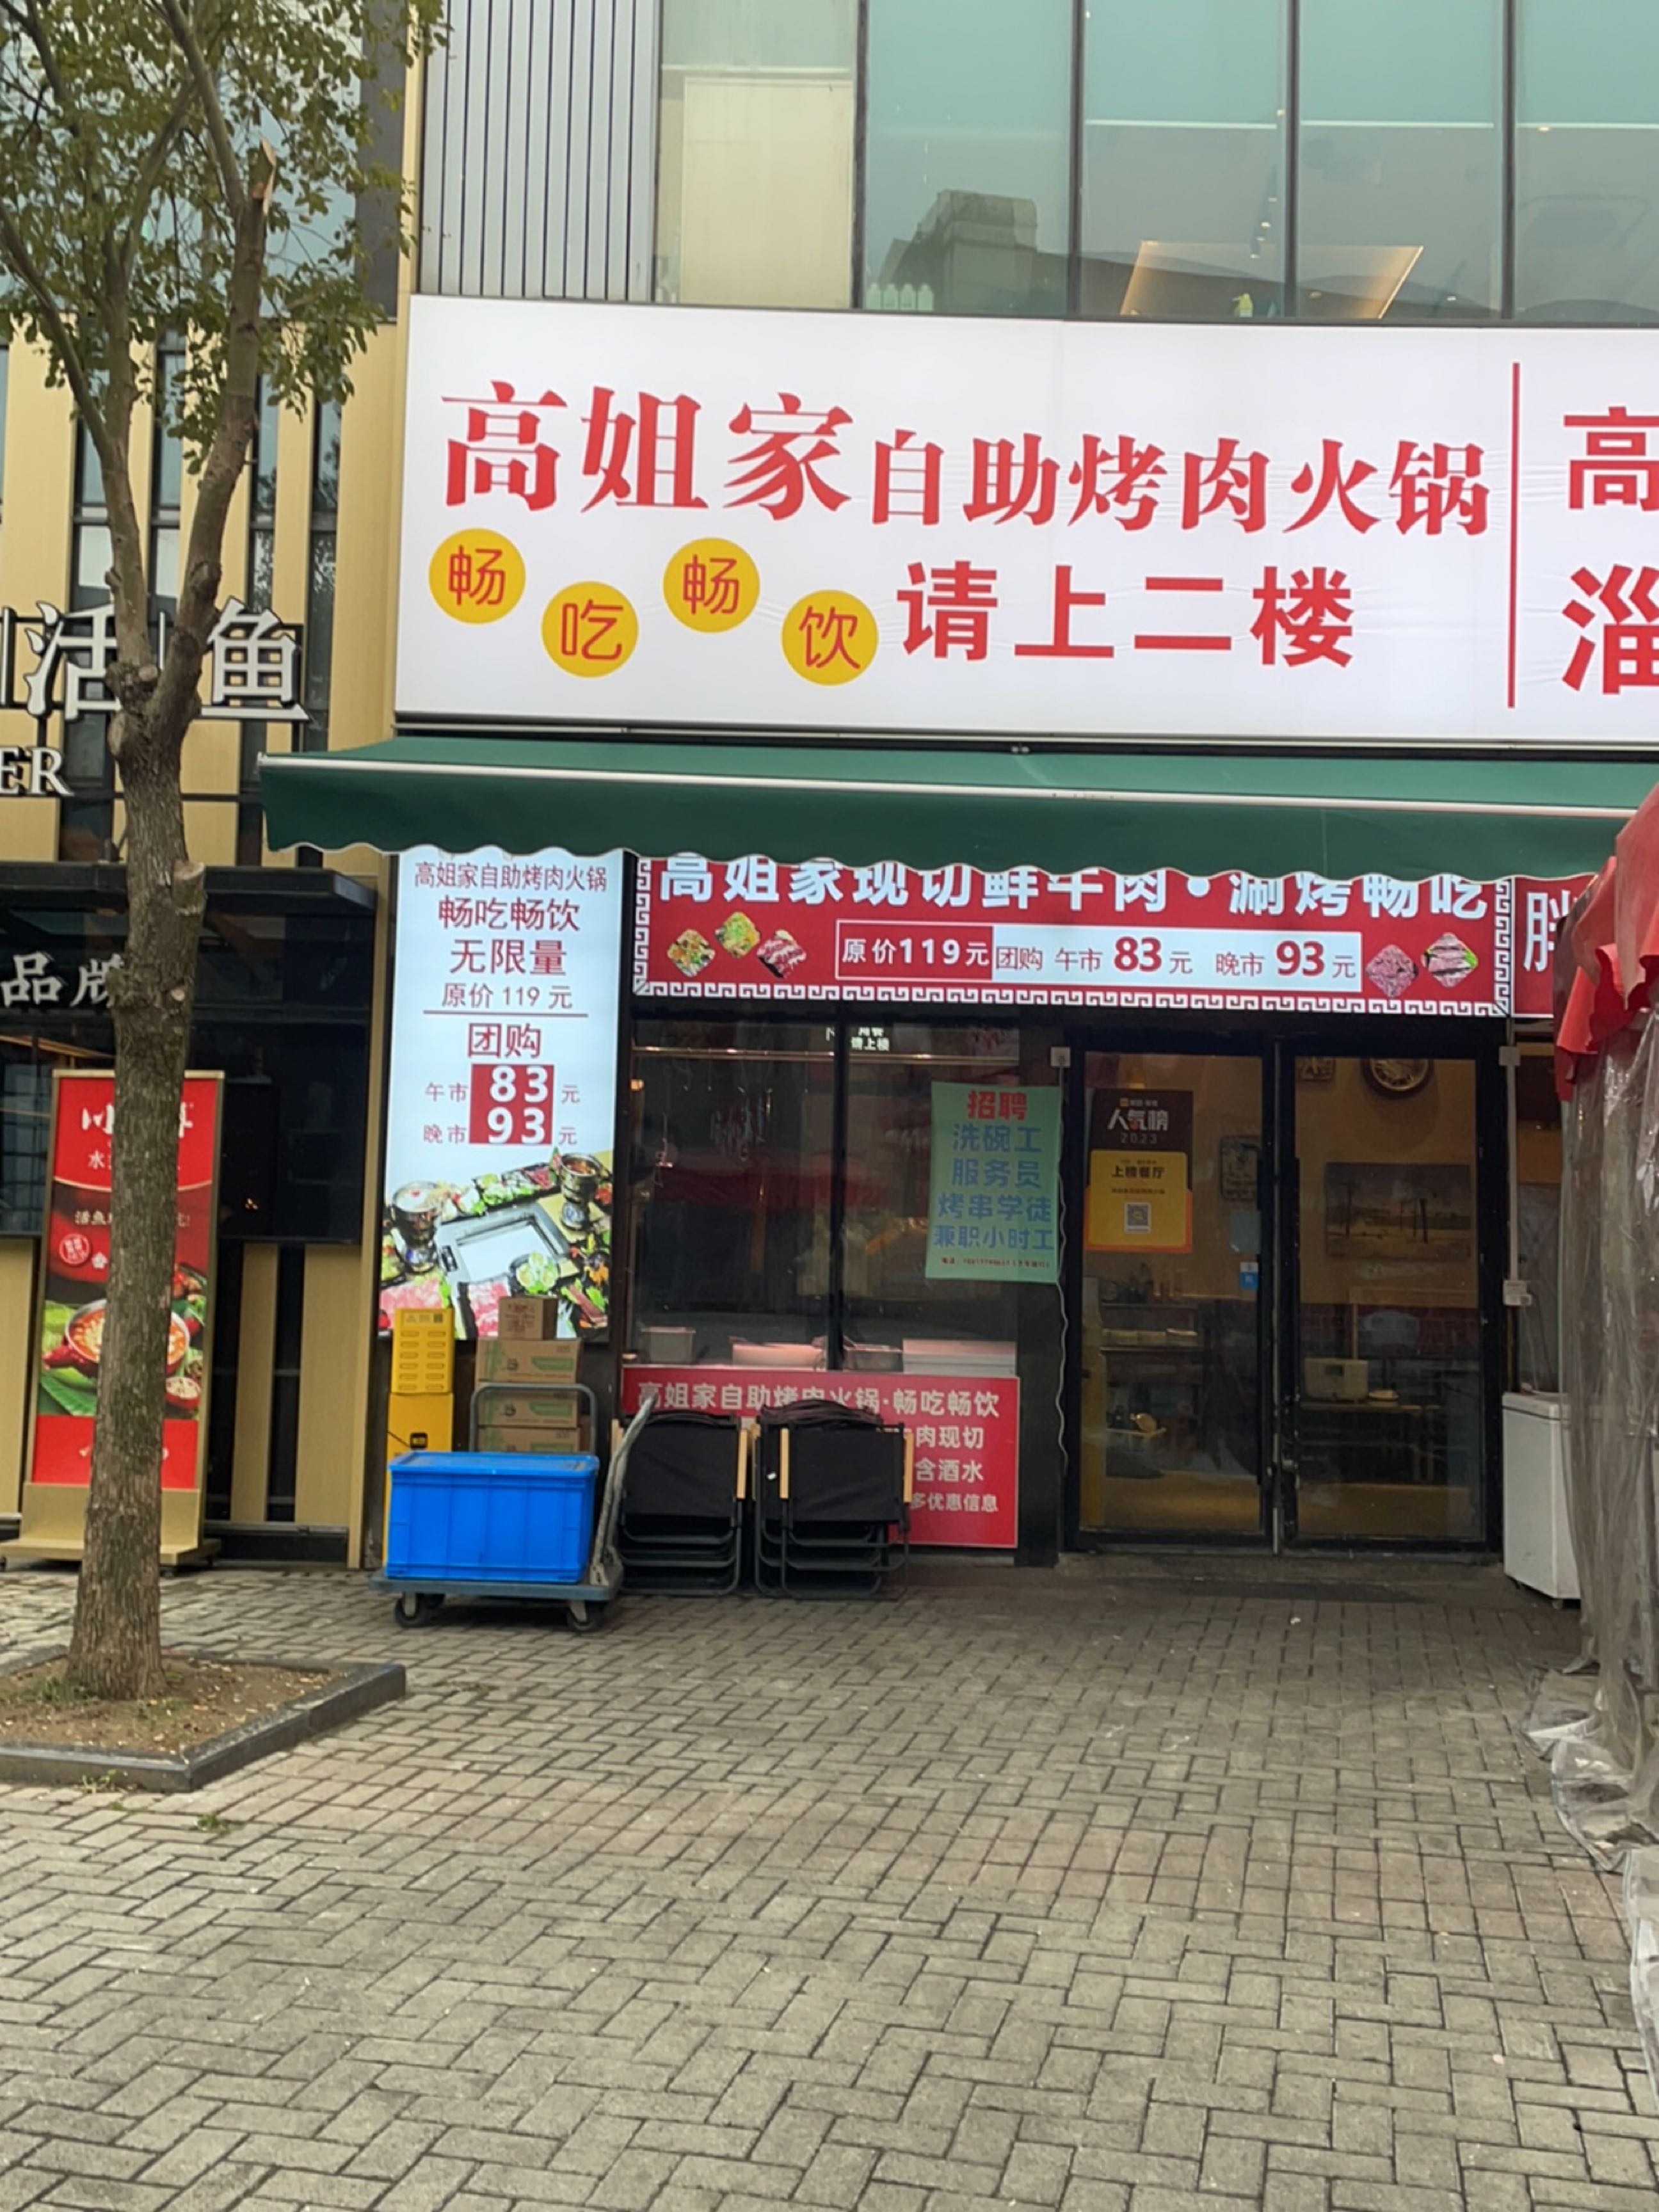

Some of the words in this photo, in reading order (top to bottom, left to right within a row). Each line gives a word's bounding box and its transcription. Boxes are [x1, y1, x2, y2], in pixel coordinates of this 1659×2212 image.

[442, 380, 1491, 536] 高姐家自助烤肉火锅
[1563, 406, 1659, 512] 高
[897, 559, 1354, 668] 请上二楼
[414, 861, 607, 892] 高姐家自助烤肉火锅
[438, 895, 581, 932] 畅吃畅饮
[449, 939, 567, 976] 无限量
[841, 936, 990, 966] 原价119元
[467, 1022, 541, 1059] 团购
[967, 1091, 1027, 1121] 招聘
[1107, 1109, 1169, 1132] 人气榜
[953, 1124, 1042, 1153] 洗碗工
[952, 1158, 1041, 1189] 服务员
[938, 1192, 1052, 1223] 烤串学徒
[934, 1224, 1055, 1250] 兼职小时工
[903, 1425, 984, 1449] 肉现切
[915, 1457, 984, 1484] 含酒水
